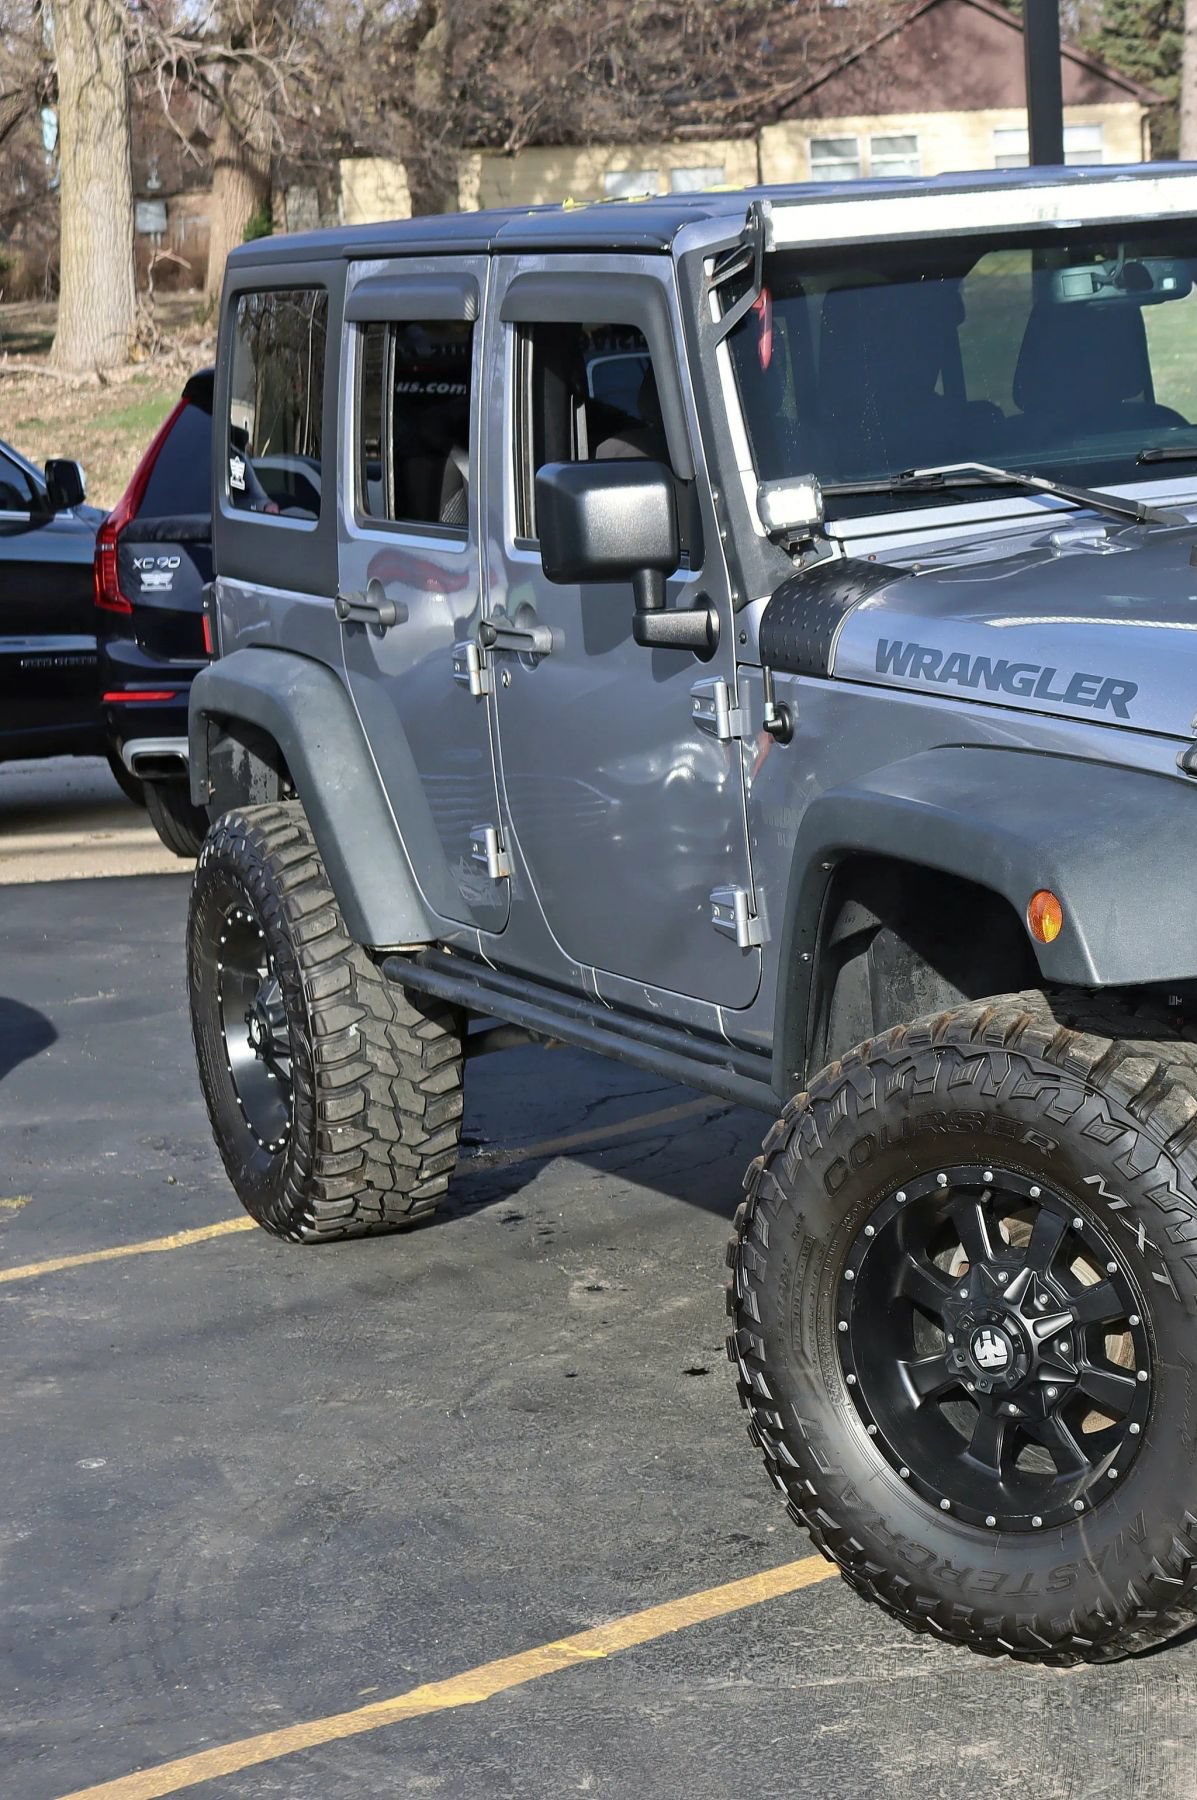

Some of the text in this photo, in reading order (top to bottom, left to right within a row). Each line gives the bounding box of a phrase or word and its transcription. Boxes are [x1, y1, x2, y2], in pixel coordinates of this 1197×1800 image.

[875, 638, 1139, 719] WRANGLER
[823, 1110, 1061, 1198] COURSER
[1083, 1173, 1181, 1302] MXT
